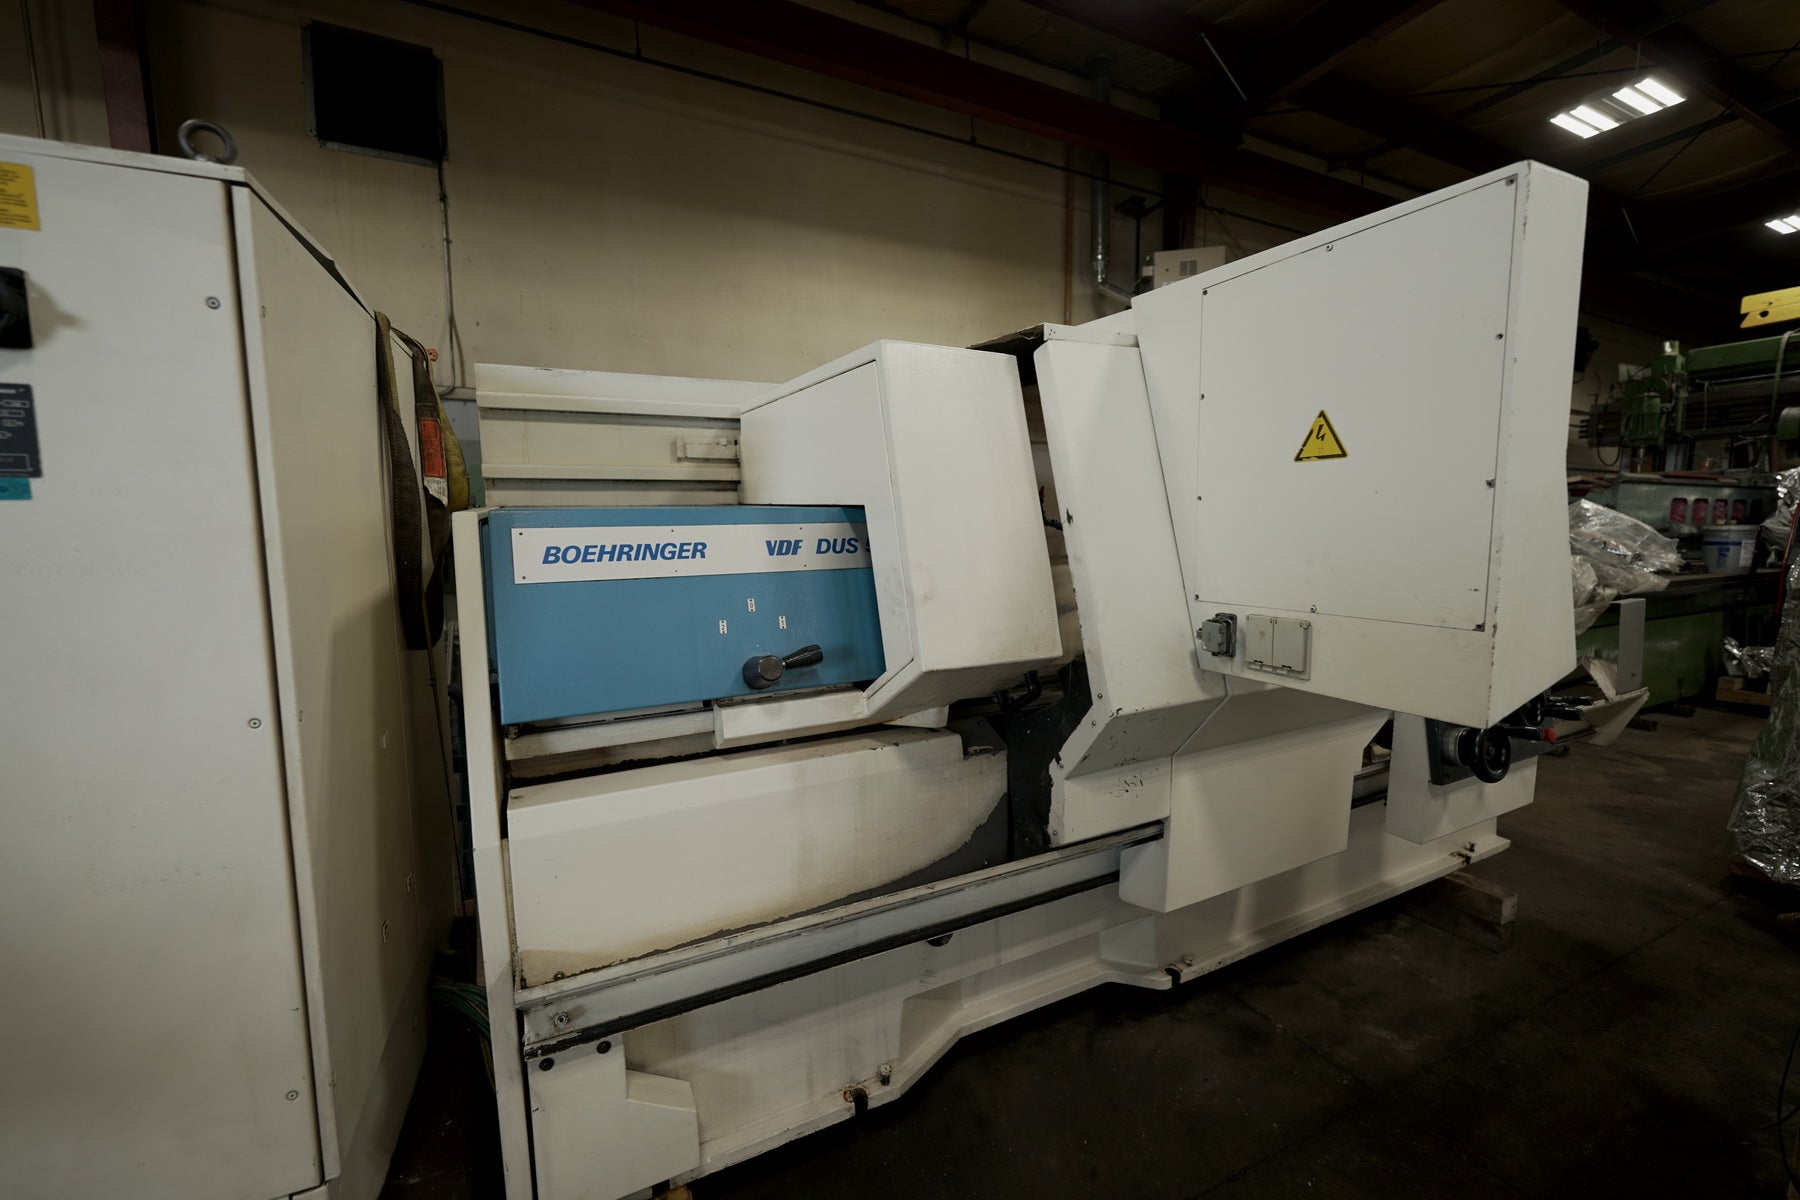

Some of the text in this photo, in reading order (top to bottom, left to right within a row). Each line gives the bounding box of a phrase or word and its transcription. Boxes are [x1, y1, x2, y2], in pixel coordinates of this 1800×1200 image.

[542, 542, 707, 565] BOEHRINGER
[765, 540, 803, 556] VDF
[815, 537, 859, 555] DUS
